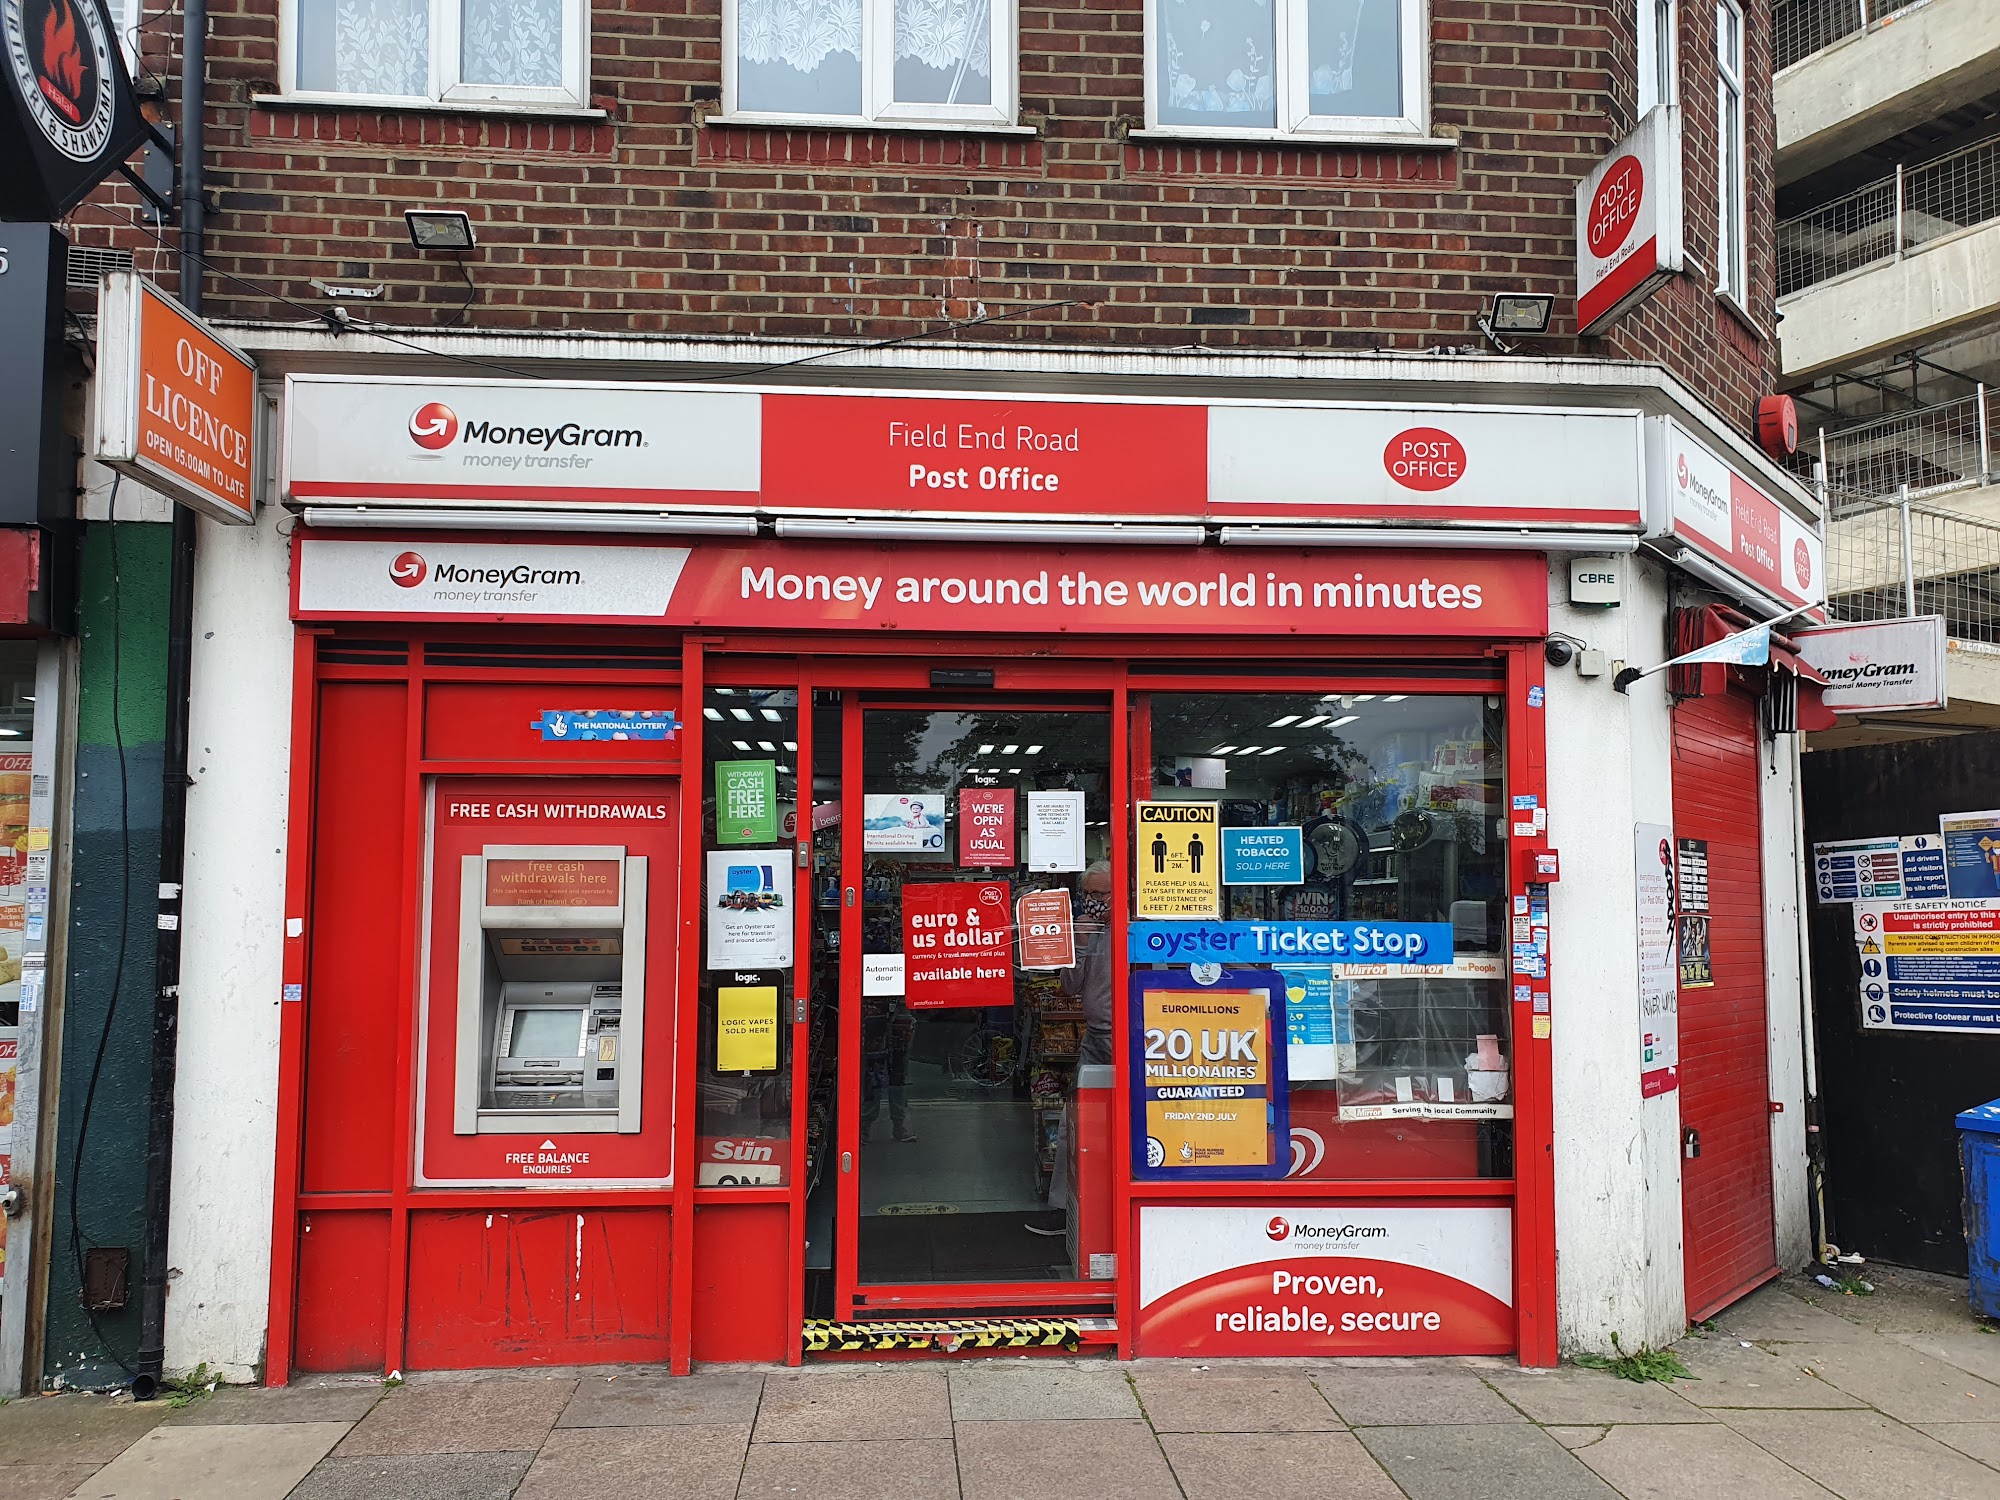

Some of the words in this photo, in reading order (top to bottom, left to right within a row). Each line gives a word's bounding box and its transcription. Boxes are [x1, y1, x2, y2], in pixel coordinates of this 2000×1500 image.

[47, 84, 75, 116] Halal
[62, 78, 111, 153] SHAWARMA
[1599, 167, 1632, 216] POST
[1592, 189, 1637, 245] OFFICE
[1595, 265, 1609, 281] Field
[1609, 254, 1620, 270] End
[1620, 239, 1635, 261] Road
[176, 338, 223, 396] OFF
[145, 372, 248, 469] LICENCE
[463, 420, 643, 451] MoneyGram
[889, 421, 947, 448] Field
[958, 424, 1006, 450] End
[1017, 425, 1079, 452] Road
[1402, 441, 1452, 459] POST
[146, 429, 173, 459] OPEN
[174, 445, 211, 481] 05.00AM
[212, 466, 225, 488] TO
[225, 474, 245, 499] LATE
[462, 454, 523, 470] money
[524, 453, 593, 469] transfer
[1392, 460, 1458, 478] OFFICE
[909, 464, 969, 489] Post
[979, 466, 1059, 492] Office
[1689, 472, 1729, 515] MoneyGram
[1735, 497, 1750, 525] Field
[1751, 509, 1762, 534] End
[1763, 518, 1778, 545] Road
[1740, 533, 1756, 560] Post
[1756, 543, 1775, 572] Office
[433, 564, 582, 588] MoneyGram
[1578, 573, 1615, 584] CBRE
[740, 565, 883, 610] Money
[895, 570, 1049, 606] around
[1057, 571, 1129, 607] the
[1136, 572, 1256, 608] world
[1266, 572, 1303, 608] in
[1313, 573, 1483, 610] minutes
[433, 591, 482, 604] money
[483, 588, 538, 602] transfer
[1855, 680, 1881, 690] Money
[1882, 677, 1913, 687] Transfer
[573, 722, 589, 730] THE
[589, 722, 631, 730] NATIONAL
[631, 722, 667, 730] LOTTERY
[726, 770, 764, 778] WITHDRAW
[975, 774, 999, 786] logic.
[727, 778, 765, 789] CASH
[727, 789, 765, 805] FREE
[450, 803, 491, 818] FREE
[496, 803, 539, 819] CASH
[543, 804, 667, 820] WITHDRAWALS
[728, 804, 766, 819] HERE
[972, 803, 1005, 814] WE'RE
[1142, 807, 1212, 822] CAUTION
[973, 816, 1003, 826] OPEN
[980, 828, 996, 838] AS
[1240, 835, 1284, 845] HEATED
[970, 839, 1005, 850] USUAL
[1235, 847, 1290, 857] TOBACCO
[1916, 854, 1940, 862] drivers
[528, 861, 554, 872] free
[557, 861, 585, 872] cash
[1235, 862, 1262, 871] SOLD
[1264, 861, 1291, 870] HERE
[1917, 864, 1943, 872] visitors
[500, 872, 576, 884] withdrawals
[580, 873, 607, 884] here
[1924, 873, 1945, 882] report
[1914, 884, 1926, 892] site
[1927, 882, 1947, 891] office
[1149, 904, 1168, 912] FEET
[1175, 904, 1180, 912] 2
[1181, 904, 1213, 912] METERS
[1893, 902, 1913, 911] SITE
[1914, 901, 1949, 910] SAFETY
[1951, 900, 1987, 909] NOTICE
[911, 912, 958, 929] euro
[965, 907, 980, 926] &
[1893, 912, 1946, 921] Unauthorised
[1947, 912, 1968, 921] entry
[1970, 911, 1979, 919] to
[1980, 911, 1996, 919] this
[1921, 921, 1950, 931] strictly
[1951, 920, 1993, 930] prohibited
[912, 934, 936, 948] us
[943, 928, 1004, 947] dollar
[1148, 926, 1242, 957] oyster
[1250, 925, 1346, 953] Ticket
[1353, 928, 1424, 958] Stop
[912, 967, 973, 982] available
[977, 966, 1006, 979] here
[1468, 962, 1497, 973] People
[734, 972, 761, 984] logic.
[875, 974, 893, 982] door
[1161, 1004, 1240, 1015] EUROMILLIONS
[748, 1018, 774, 1026] VAPES
[1145, 1028, 1194, 1062] 20
[1200, 1029, 1259, 1062] UK
[1146, 1063, 1256, 1079] MILLIONAIRES
[1157, 1085, 1245, 1099] GUARANTEED
[1164, 1112, 1195, 1121] FRIDAY
[1196, 1112, 1215, 1121] 2ND
[1215, 1112, 1238, 1121] JULY
[1356, 1107, 1384, 1117] Mirror
[1392, 1107, 1422, 1116] Serving
[1434, 1107, 1453, 1115] local
[1455, 1106, 1497, 1116] Community
[505, 1153, 535, 1164] FREE
[538, 1152, 590, 1164] BALANCE
[711, 1140, 773, 1162] Sun
[522, 1165, 572, 1175] ENQUIRIES
[1294, 1224, 1387, 1241] MoneyGram
[1294, 1242, 1324, 1251] money
[1325, 1241, 1361, 1250] transfer
[1272, 1270, 1384, 1299] Proven,
[1215, 1305, 1335, 1336] reliable,
[1340, 1310, 1441, 1333] secure
